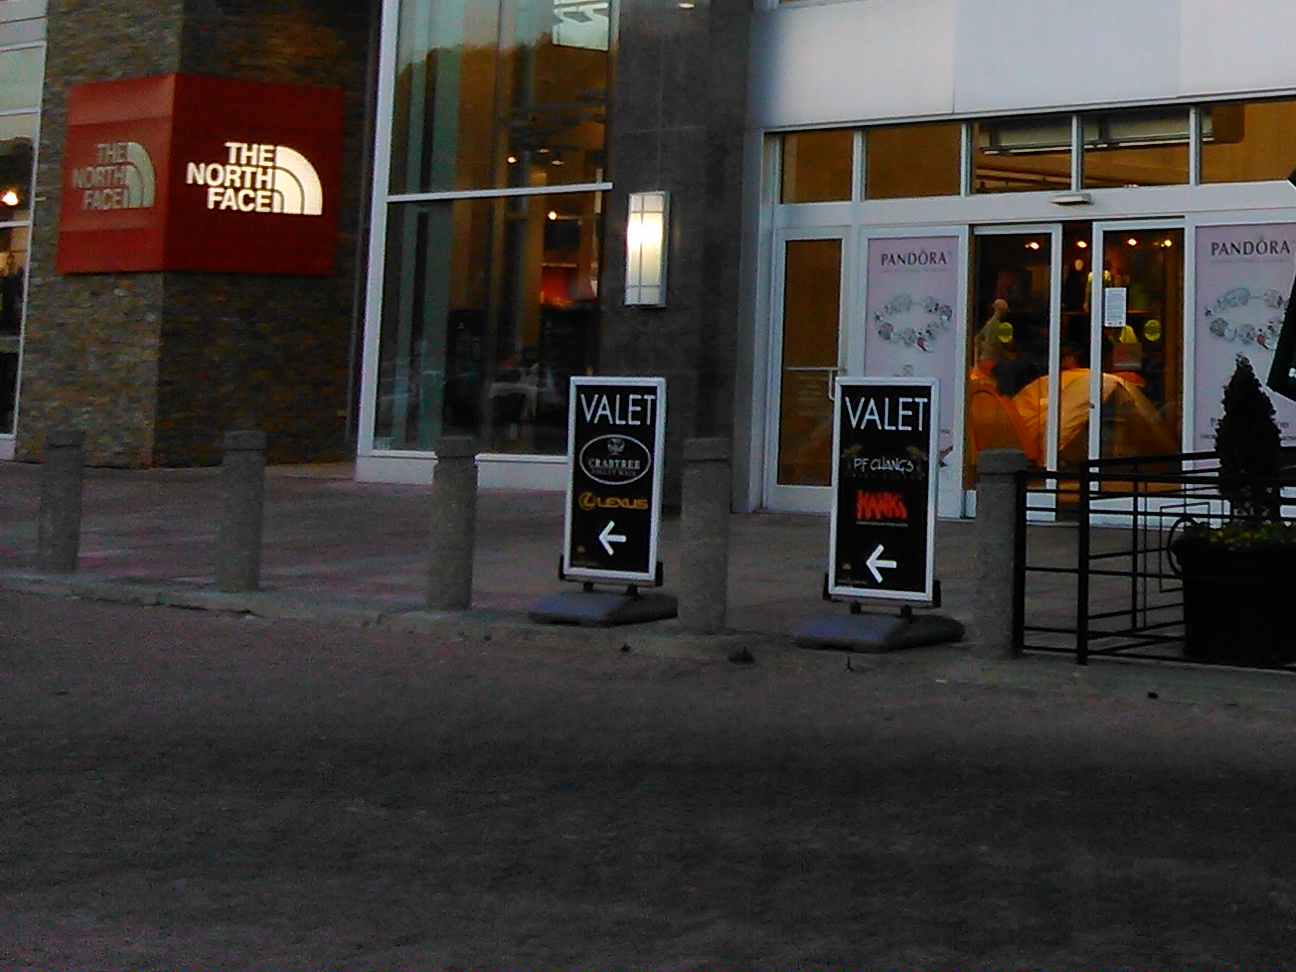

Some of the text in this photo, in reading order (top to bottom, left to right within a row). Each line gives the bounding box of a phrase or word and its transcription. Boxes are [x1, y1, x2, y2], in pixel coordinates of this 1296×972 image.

[97, 142, 128, 163] THE
[224, 142, 276, 167] THE
[73, 166, 127, 189] NORTH
[186, 163, 273, 190] NORTH
[83, 190, 125, 211] FACE
[207, 188, 272, 213] FACE
[880, 248, 948, 266] PANDORA
[1210, 238, 1291, 257] PANDORA
[580, 394, 656, 425] VALET
[845, 396, 928, 431] VALET
[588, 457, 641, 470] CRABTREE
[597, 497, 649, 510] LEXUS
